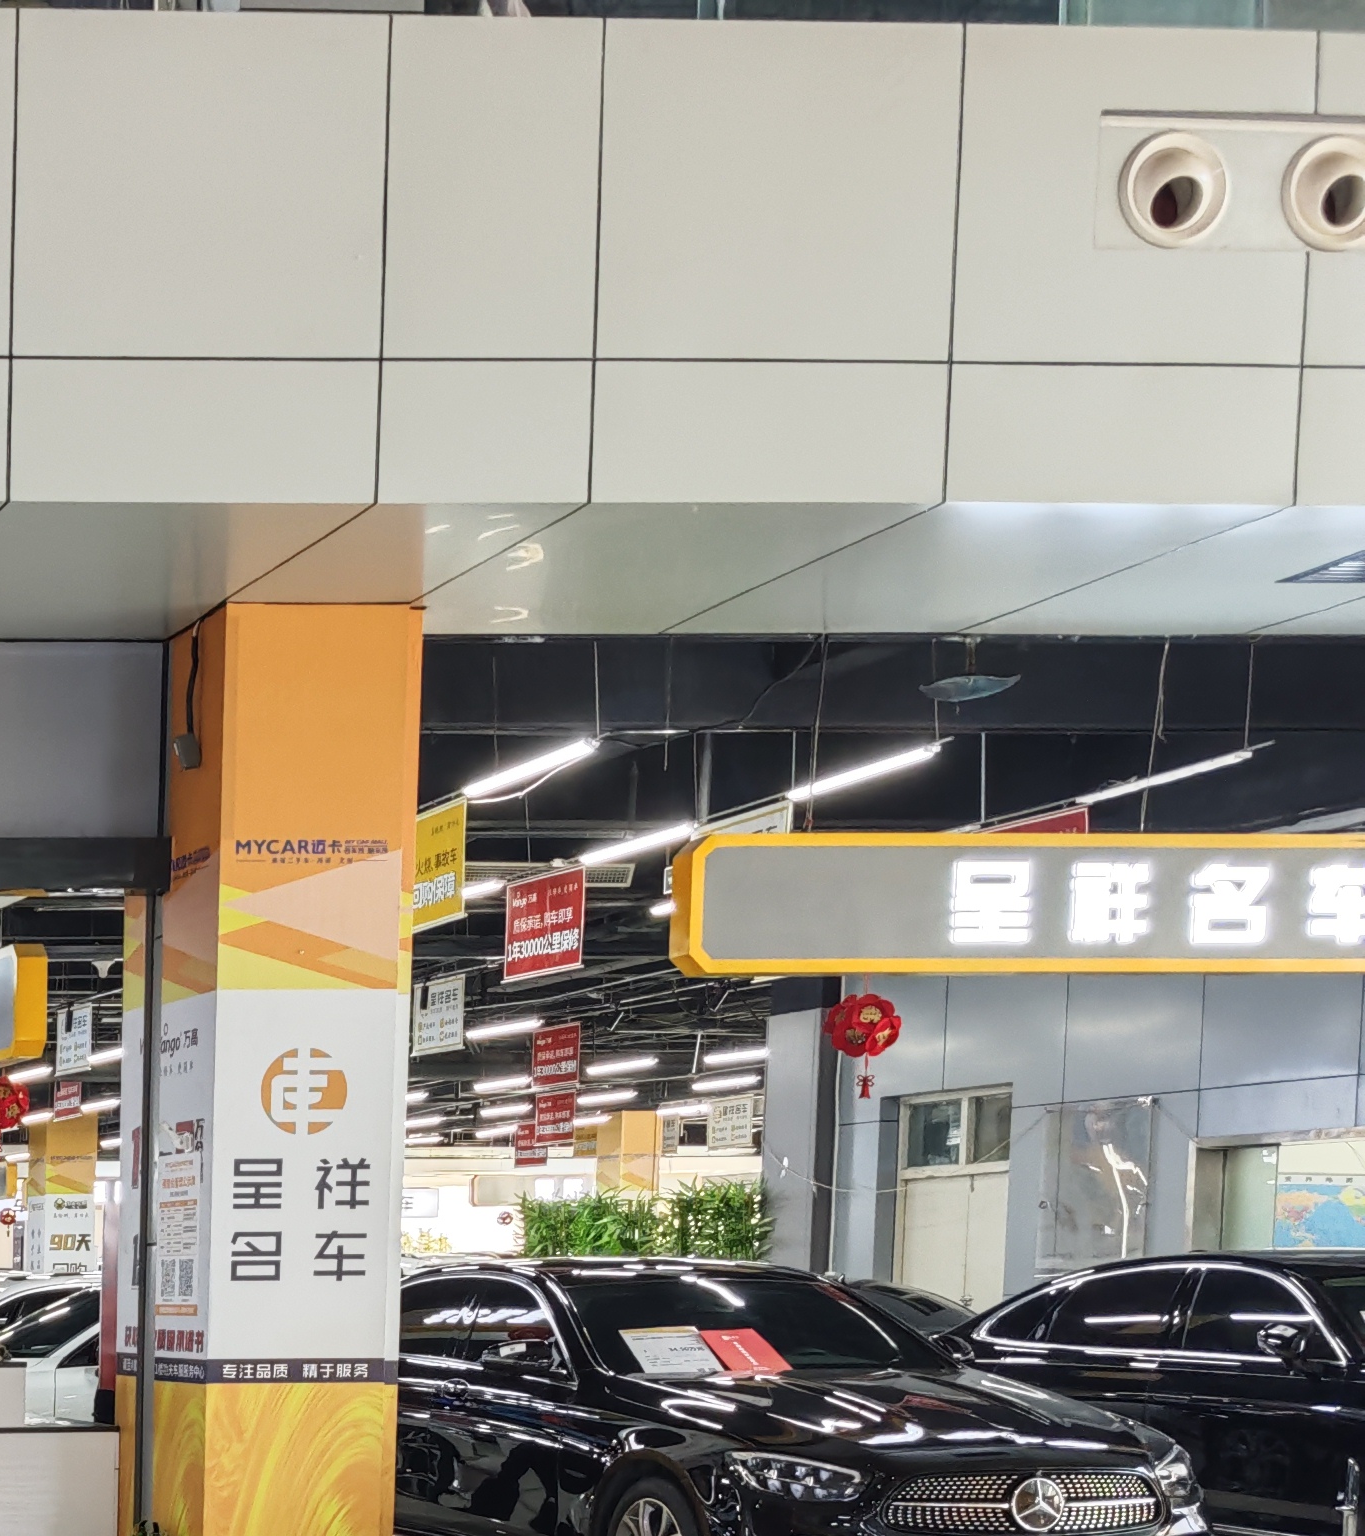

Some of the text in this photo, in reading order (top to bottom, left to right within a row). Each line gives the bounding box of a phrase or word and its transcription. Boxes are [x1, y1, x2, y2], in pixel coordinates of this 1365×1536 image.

[507, 928, 580, 962] 1年30000公里保修
[183, 1028, 199, 1048] 万高
[232, 1157, 371, 1210] 呈祥
[49, 1233, 91, 1252] 90天
[231, 1230, 368, 1282] 名车
[222, 1363, 369, 1379] 专注品质 精于服务
